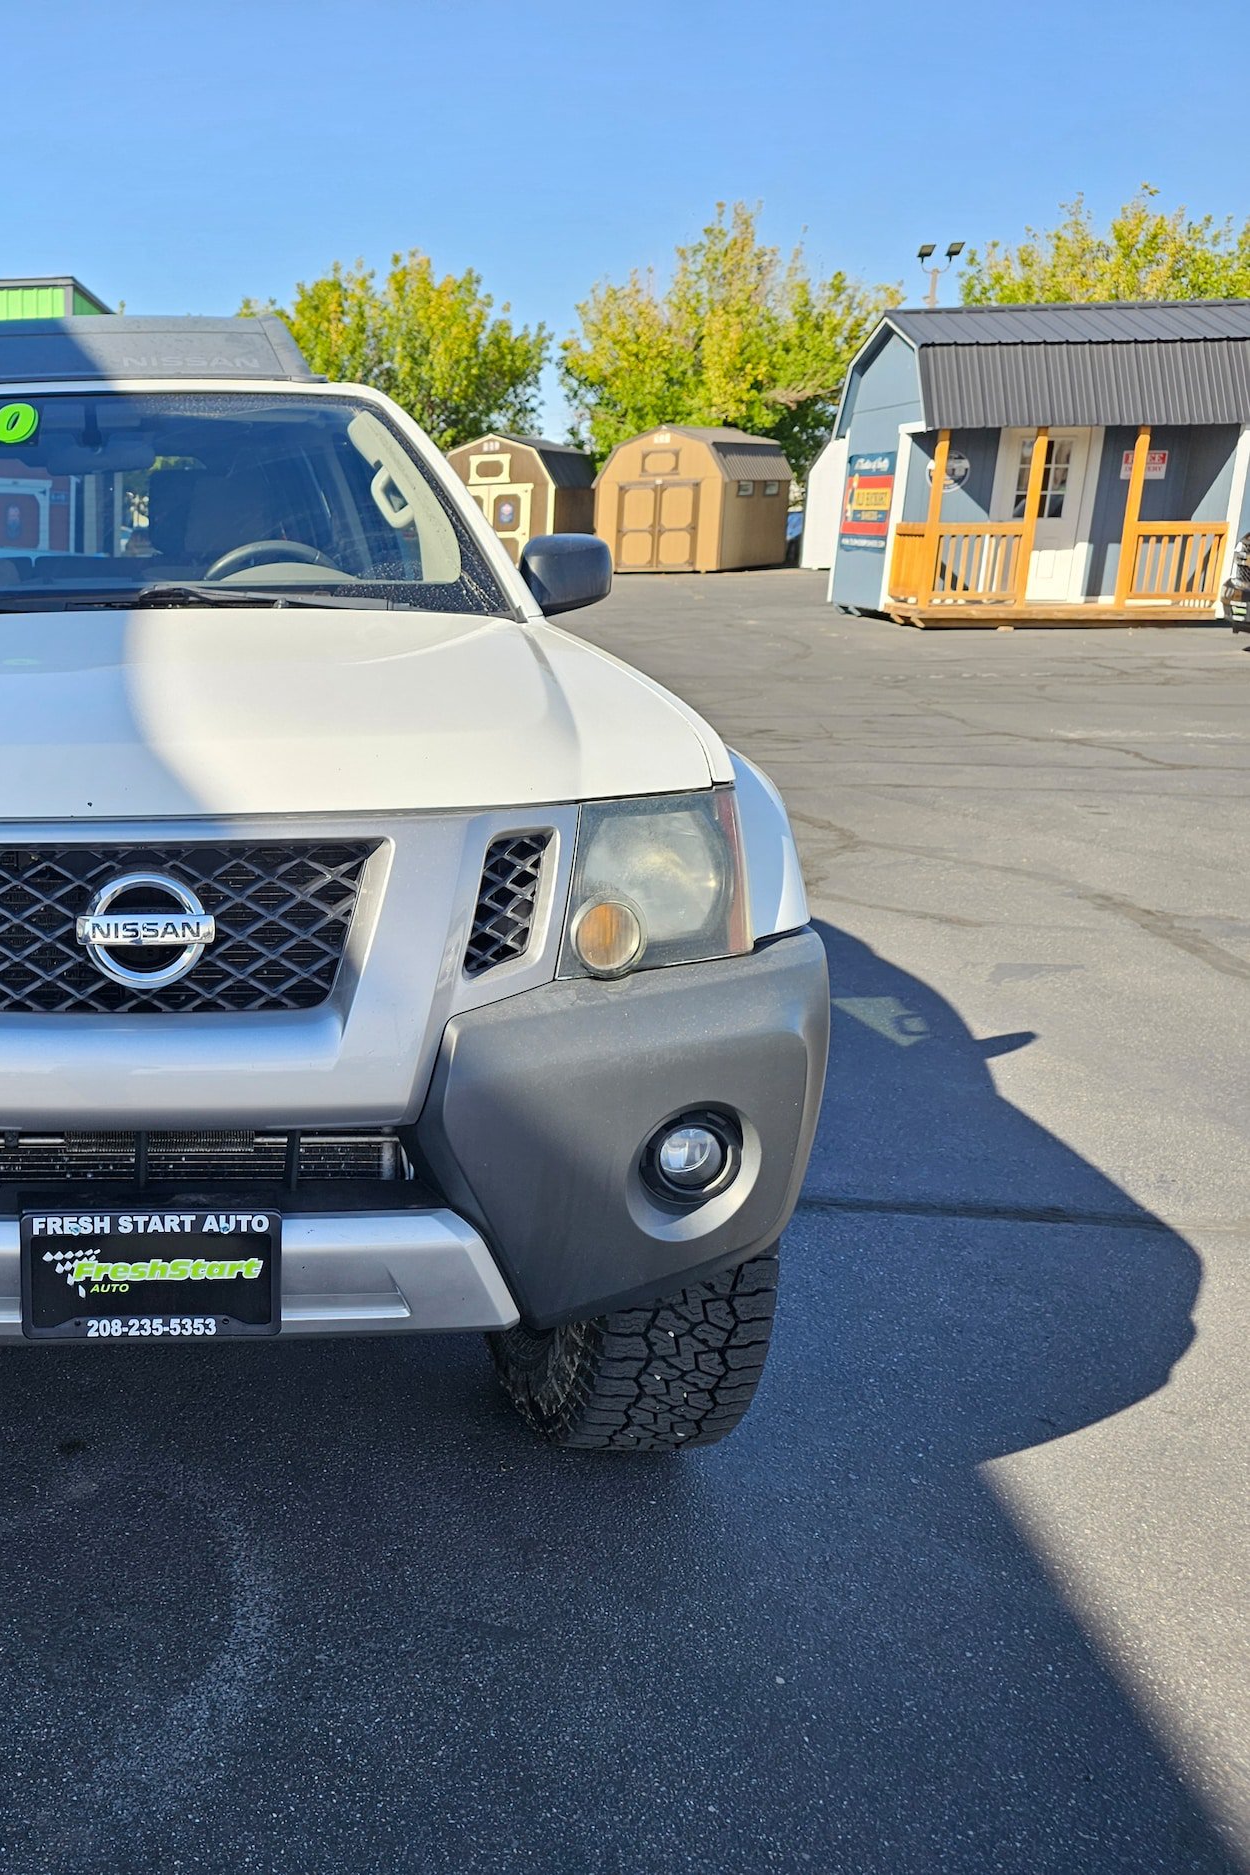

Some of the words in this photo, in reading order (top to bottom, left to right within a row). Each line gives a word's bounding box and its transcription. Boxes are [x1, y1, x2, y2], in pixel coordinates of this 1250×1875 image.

[122, 355, 260, 368] NISSAN
[91, 921, 200, 939] NISSAN
[32, 1216, 111, 1235] FRESH
[117, 1215, 196, 1234] START
[202, 1215, 270, 1234] AUTO
[73, 1258, 264, 1282] FreshStart
[90, 1283, 130, 1293] AUTO
[86, 1317, 217, 1338] 208-235-5353
